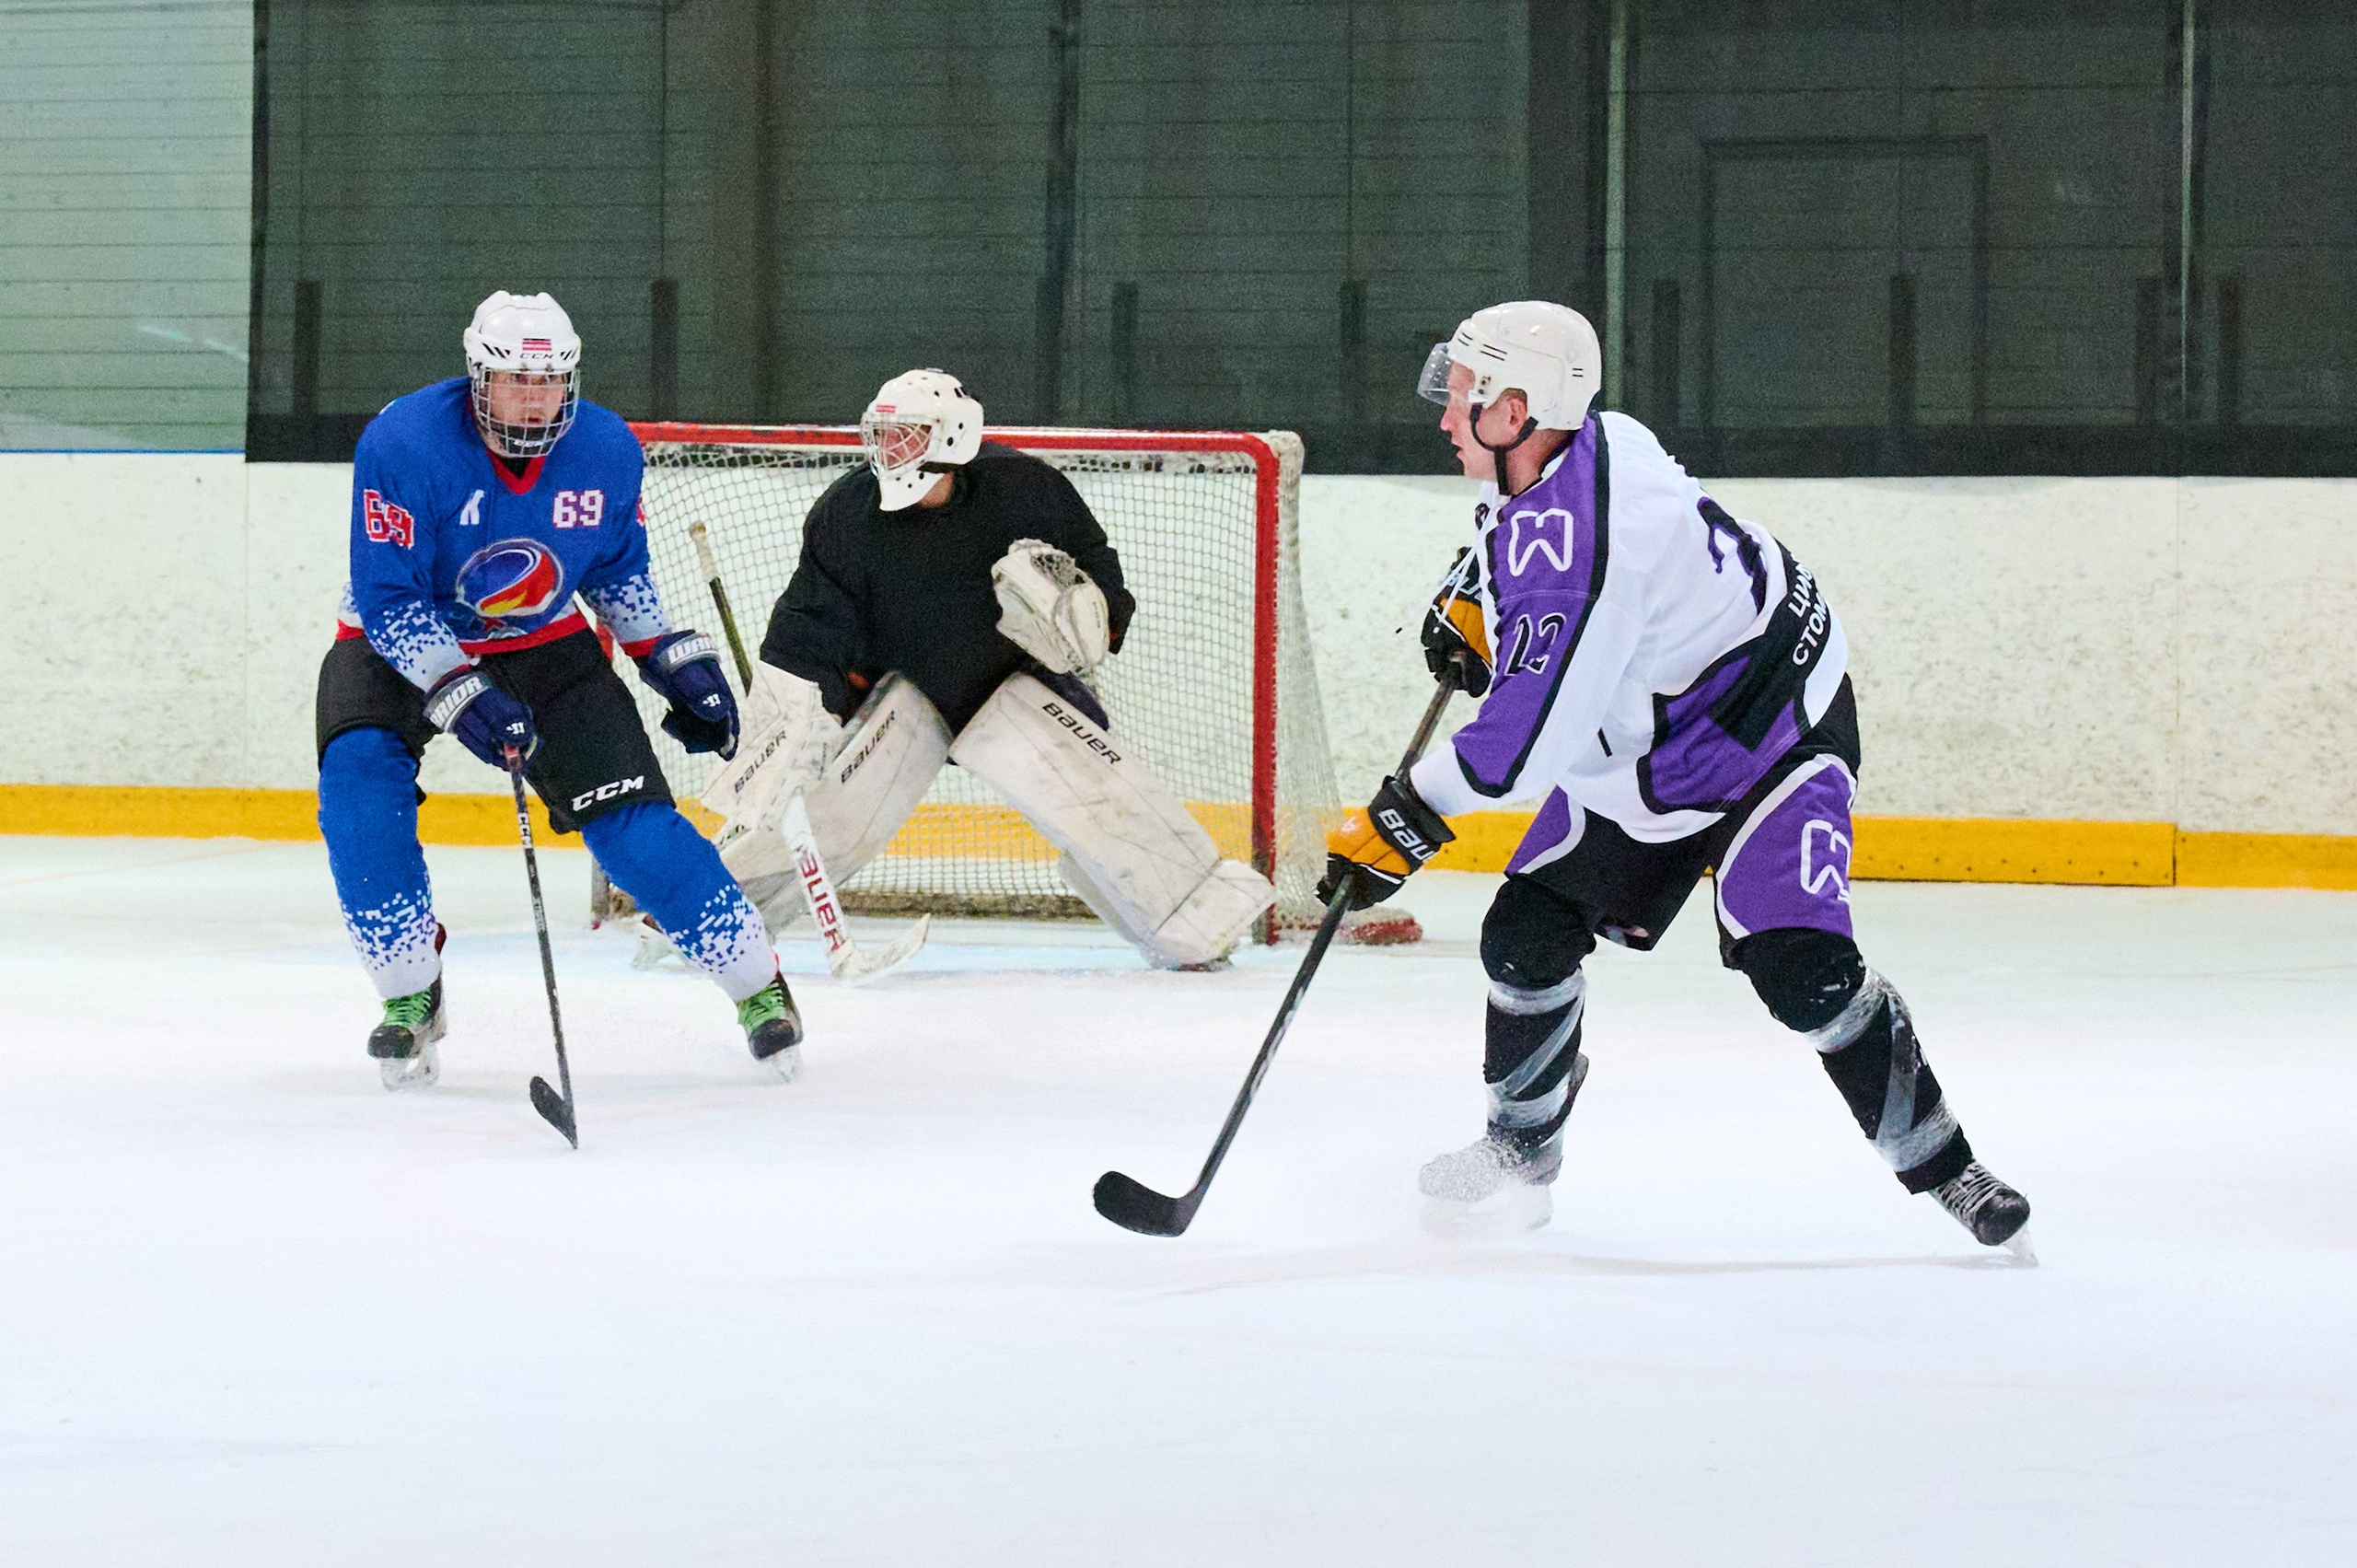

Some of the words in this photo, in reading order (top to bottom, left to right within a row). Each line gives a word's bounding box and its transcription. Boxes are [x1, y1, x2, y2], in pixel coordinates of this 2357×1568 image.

[364, 489, 414, 550] 69
[552, 489, 604, 528] 69
[734, 729, 787, 794] BAUER
[842, 710, 896, 784] BAUER
[1042, 703, 1121, 764] BAUER
[572, 775, 644, 812] CCM
